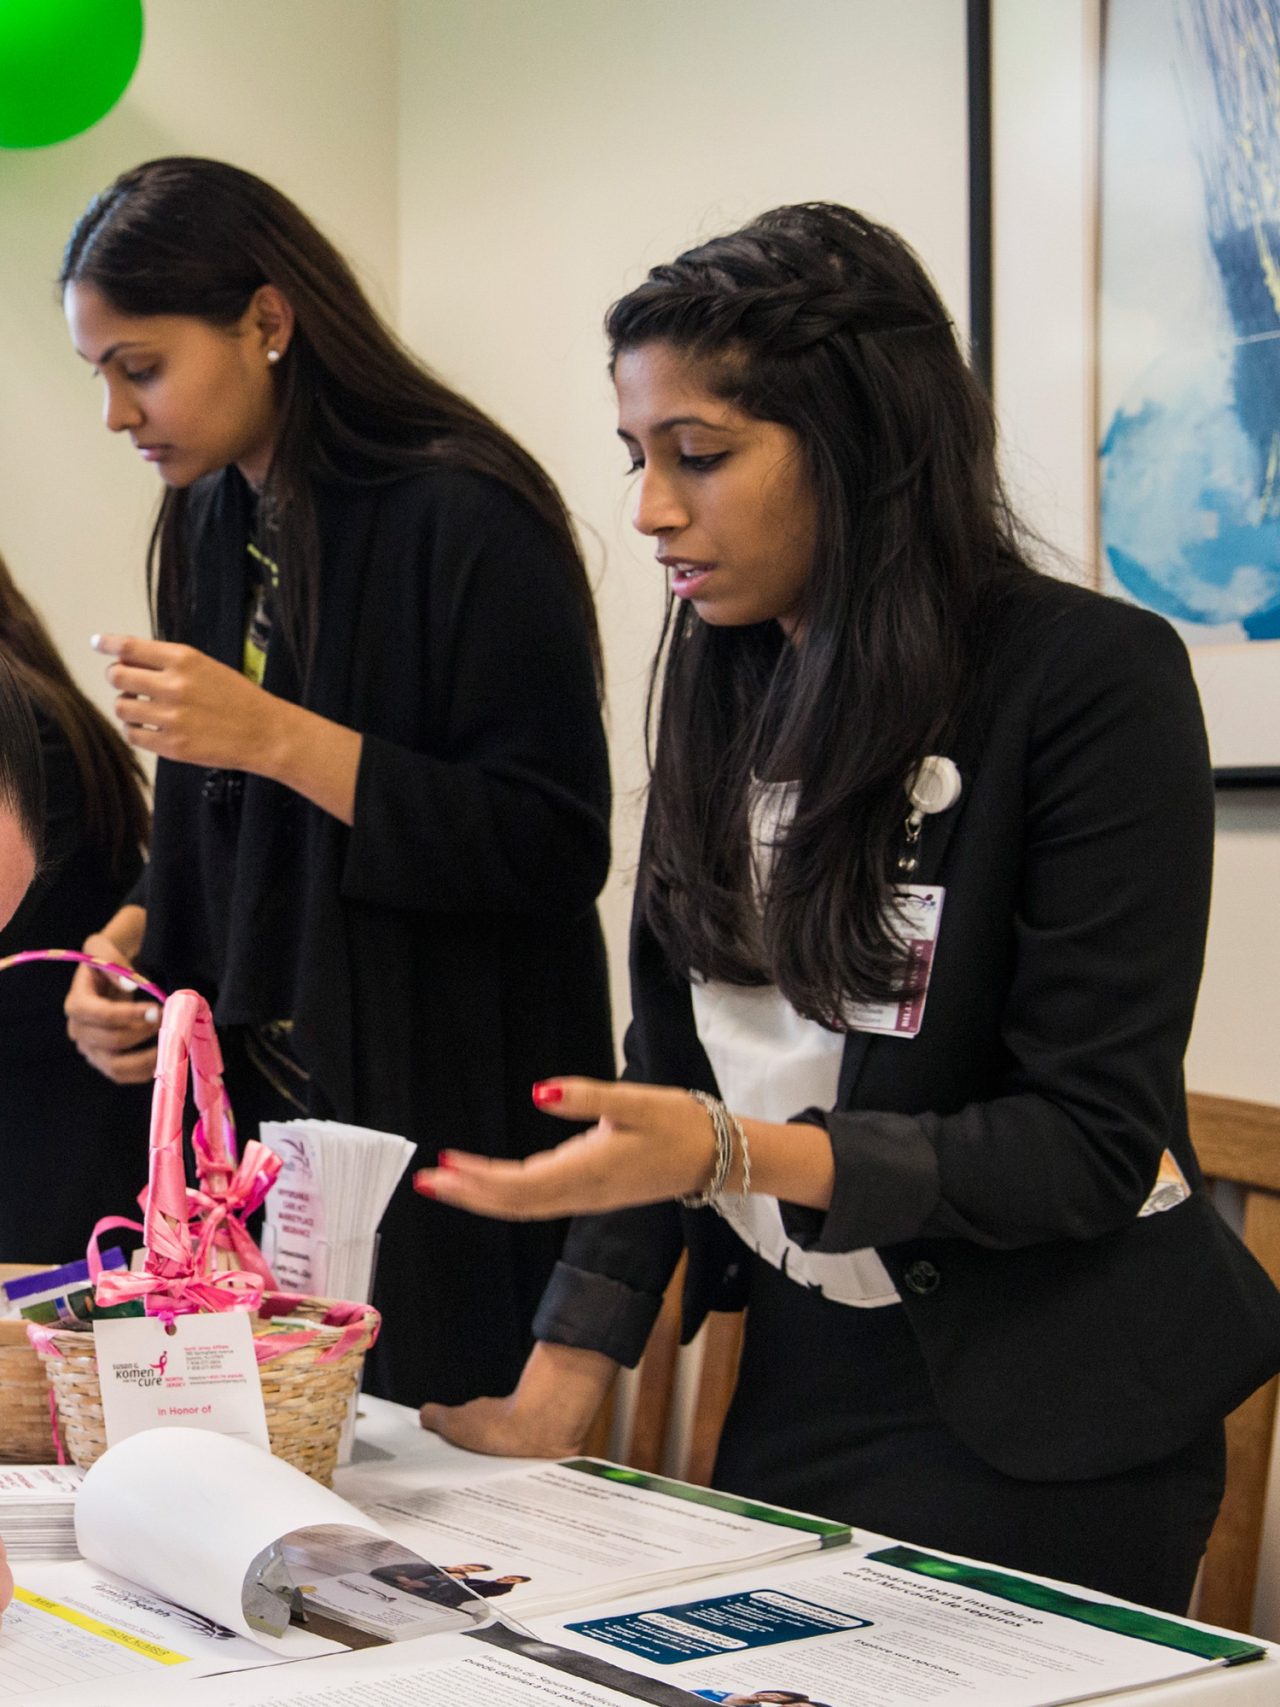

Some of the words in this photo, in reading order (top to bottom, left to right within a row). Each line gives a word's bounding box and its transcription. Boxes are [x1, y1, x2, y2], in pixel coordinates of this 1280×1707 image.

[138, 1377, 163, 1387] cure
[169, 1406, 198, 1416] Honor
[201, 1405, 212, 1415] of
[876, 1580, 940, 1602] Mercado
[940, 1600, 962, 1609] de
[962, 1606, 1024, 1628] seguros
[926, 1587, 963, 1600] para
[962, 1598, 1044, 1625] inscribirse
[853, 1639, 893, 1654] Explore
[893, 1652, 911, 1660] sus
[911, 1658, 961, 1677] opciones
